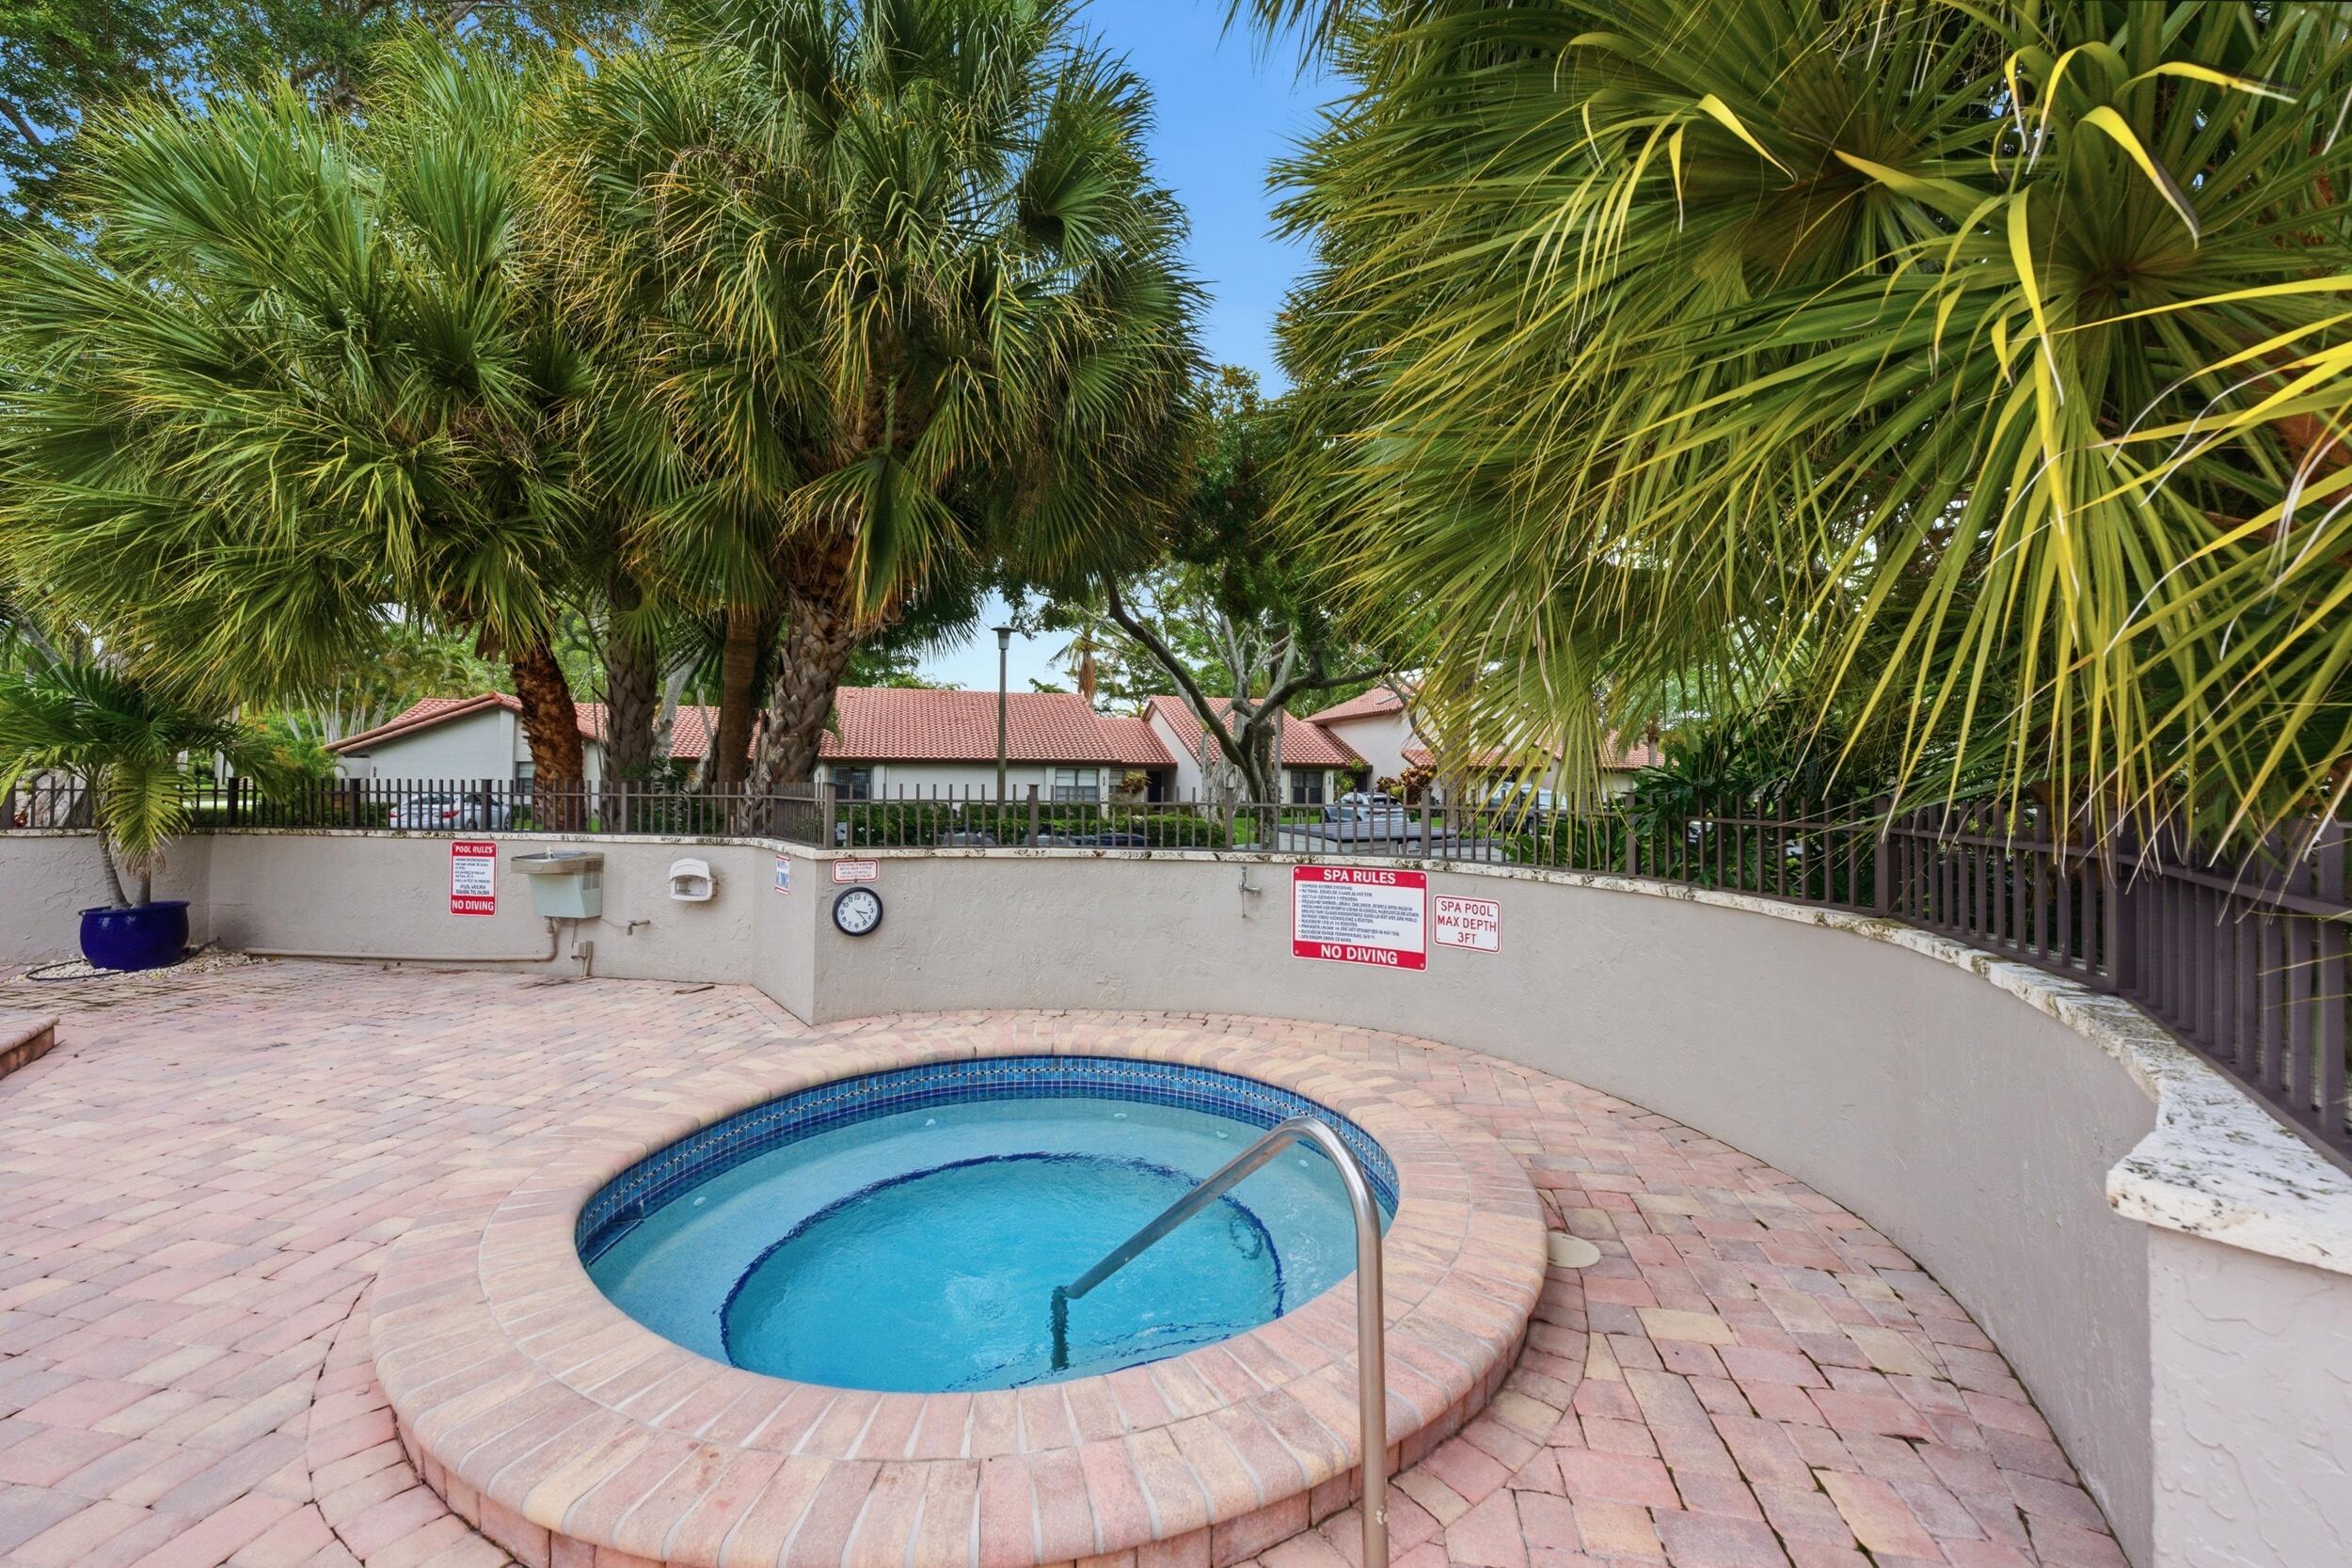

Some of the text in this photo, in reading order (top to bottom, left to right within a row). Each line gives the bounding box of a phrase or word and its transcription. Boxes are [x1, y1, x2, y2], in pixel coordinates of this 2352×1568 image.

[473, 846, 493, 854] RULES
[1324, 869, 1396, 884] SPA RULES
[452, 900, 494, 911] NO DIVING
[1440, 900, 1494, 917] SPA POOL
[1438, 914, 1497, 932] MAX DEPTH
[1457, 931, 1477, 944] 3FT
[1321, 944, 1398, 965] NO DIVING
